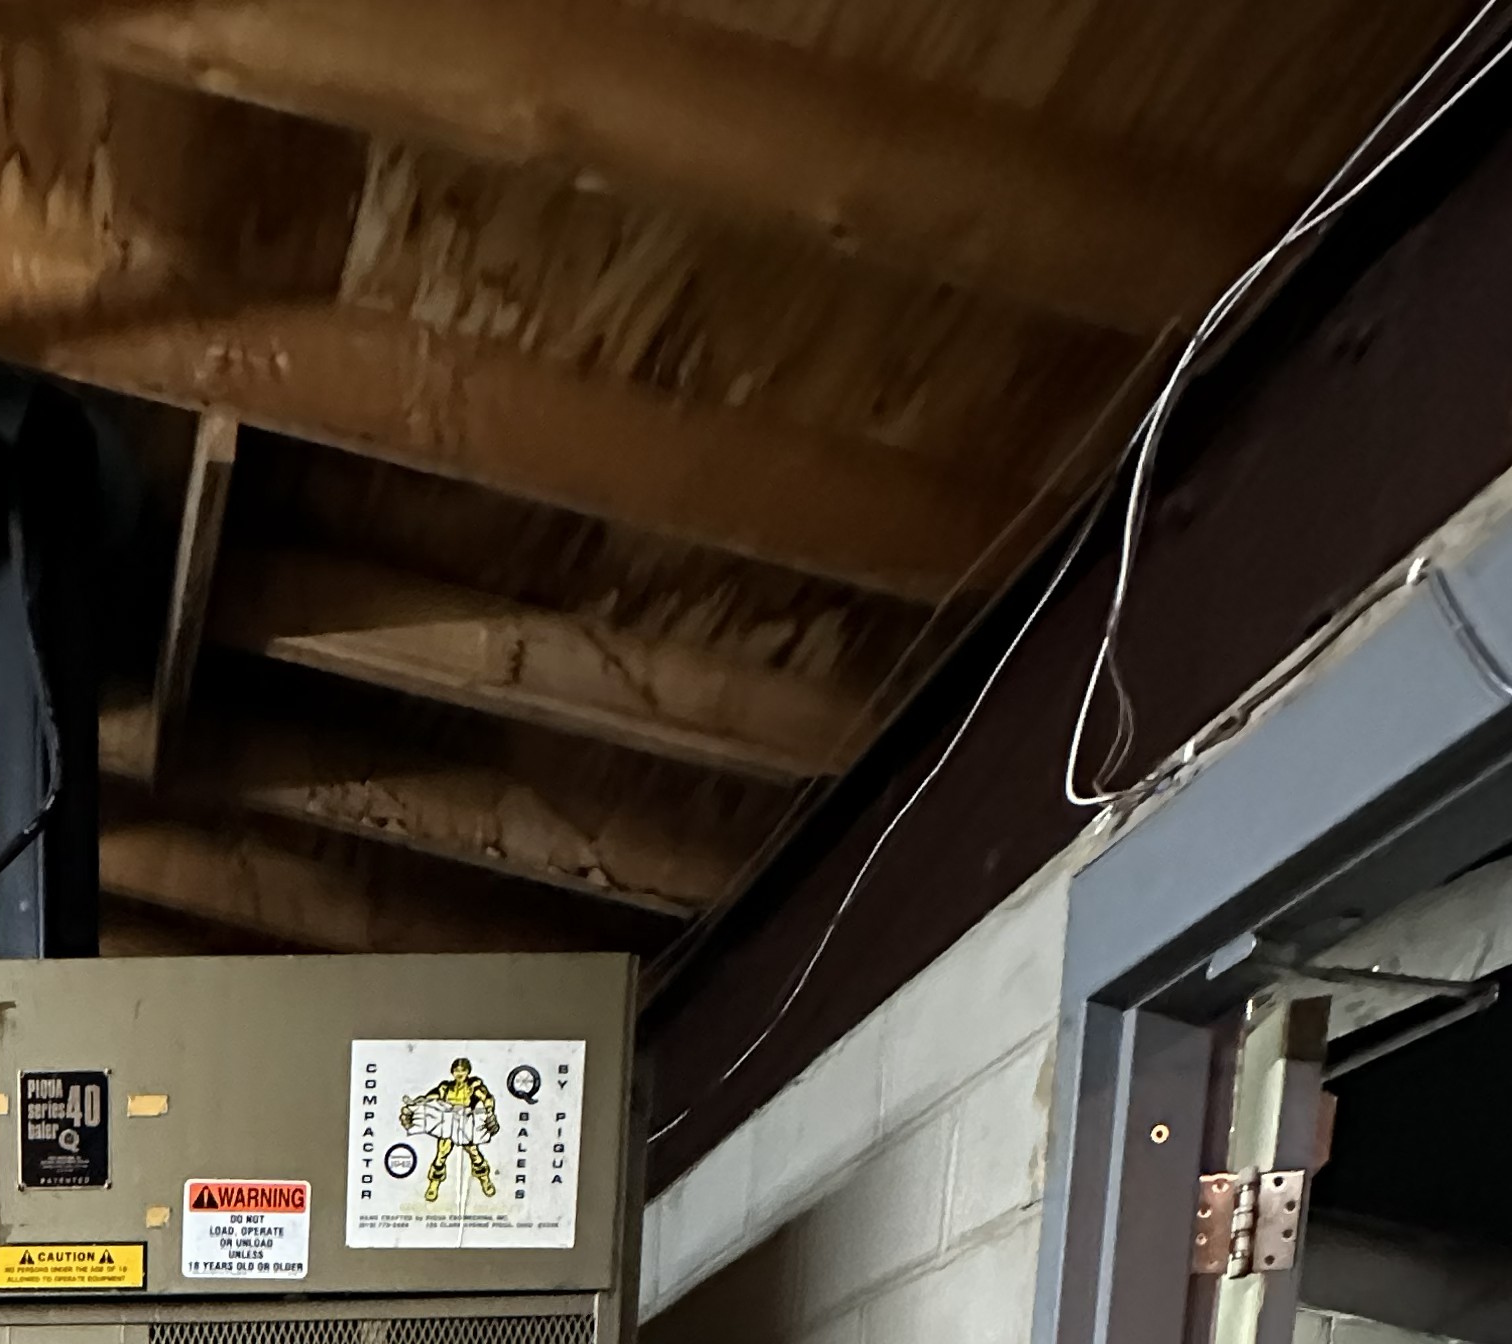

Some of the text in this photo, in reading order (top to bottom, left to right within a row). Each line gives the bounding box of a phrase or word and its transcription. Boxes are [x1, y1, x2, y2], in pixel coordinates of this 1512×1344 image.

[27, 1084, 101, 1128] series 40
[27, 1120, 59, 1140] baler
[361, 1063, 377, 1200] COMPACTOR
[514, 1112, 529, 1199] BALERS
[218, 1186, 304, 1208] WARNING
[230, 1214, 265, 1223] DO NOT
[241, 1226, 284, 1236] OPERATE
[219, 1238, 273, 1248] OR UNLOAD
[38, 1251, 96, 1262] CAUTION
[228, 1250, 264, 1259] UNLESS
[188, 1261, 304, 1272] 18 YEARS OLD OR OLDER
